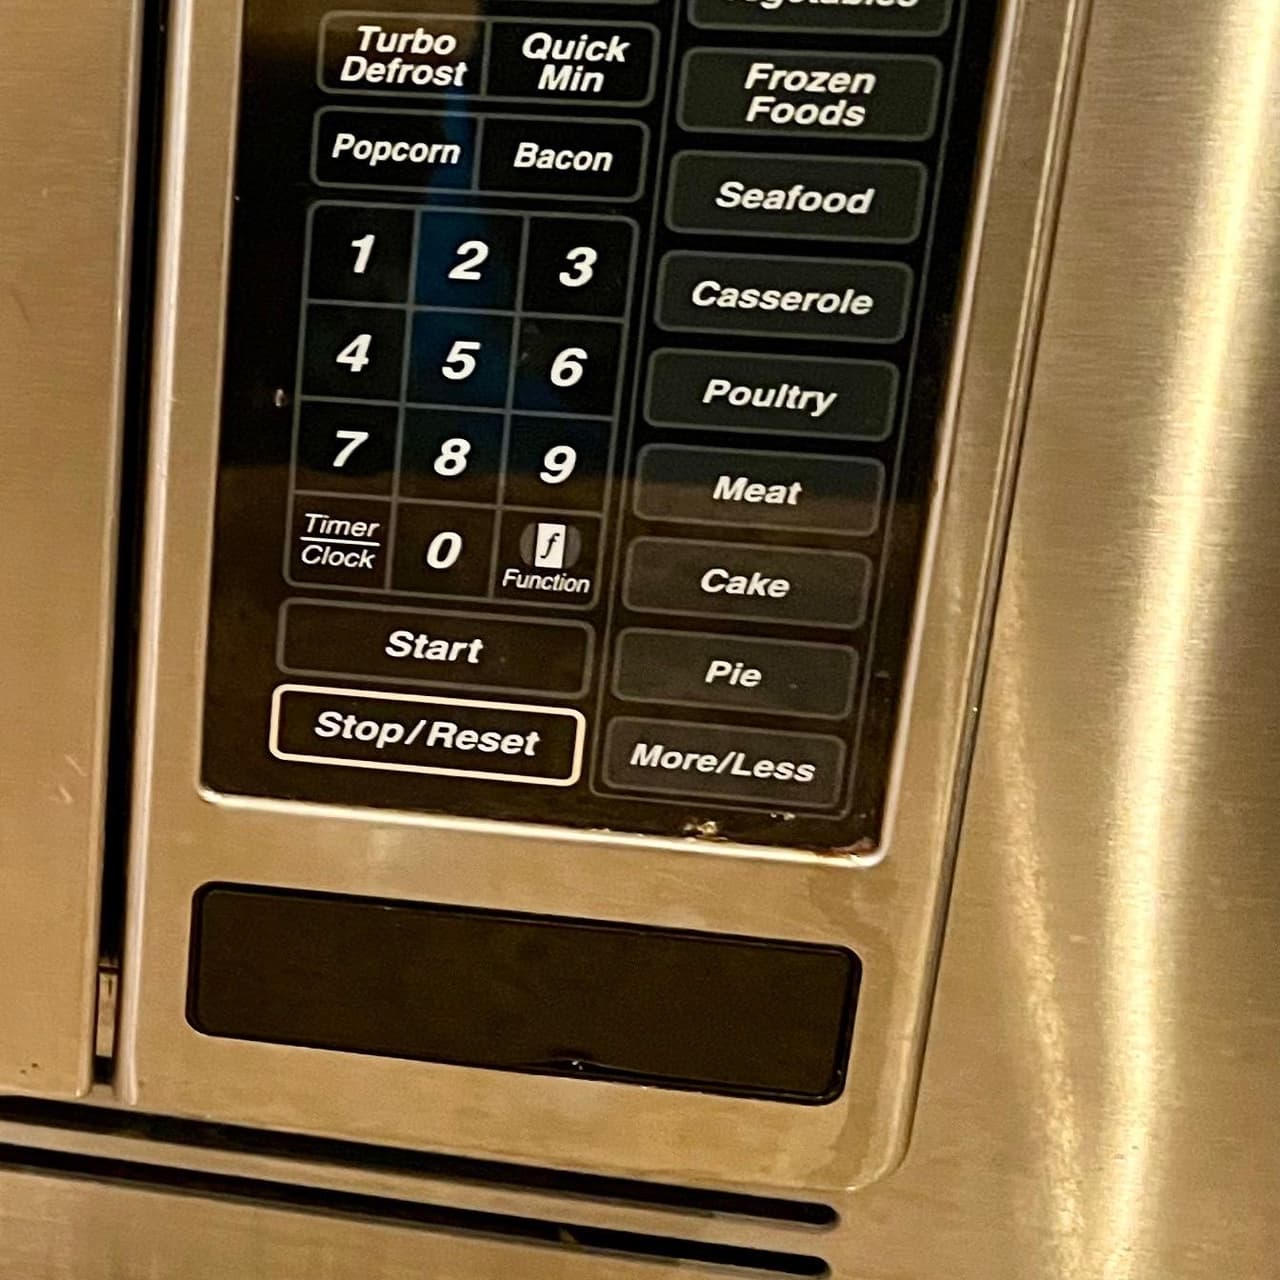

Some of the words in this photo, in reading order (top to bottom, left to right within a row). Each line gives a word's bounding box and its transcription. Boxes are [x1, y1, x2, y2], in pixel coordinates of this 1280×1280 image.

[355, 24, 458, 59] Turbo
[521, 30, 632, 65] Quick
[339, 53, 469, 88] Defrost
[536, 62, 606, 94] Min
[743, 61, 877, 96] Frozen
[744, 94, 867, 128] Foods
[330, 131, 462, 168] Popcorn
[512, 140, 614, 173] Bacon
[714, 180, 876, 215] Seafood
[350, 233, 376, 275] 1
[447, 239, 490, 282] 2
[558, 245, 599, 288] 3
[691, 279, 875, 316] Casserole
[334, 332, 373, 373] 4
[440, 339, 482, 381] 5
[549, 346, 589, 388] 6
[701, 377, 839, 418] Poultry
[331, 429, 370, 468] 7
[432, 436, 472, 477] 8
[538, 444, 578, 485] 9
[711, 474, 804, 506] Meat
[303, 511, 382, 539] Timer
[299, 542, 378, 571] Clock
[425, 530, 464, 570] 0
[500, 566, 592, 595] Function
[699, 567, 791, 599] Cake
[384, 629, 485, 665] Start
[704, 659, 763, 689] Pie
[628, 742, 817, 783] More/Less
